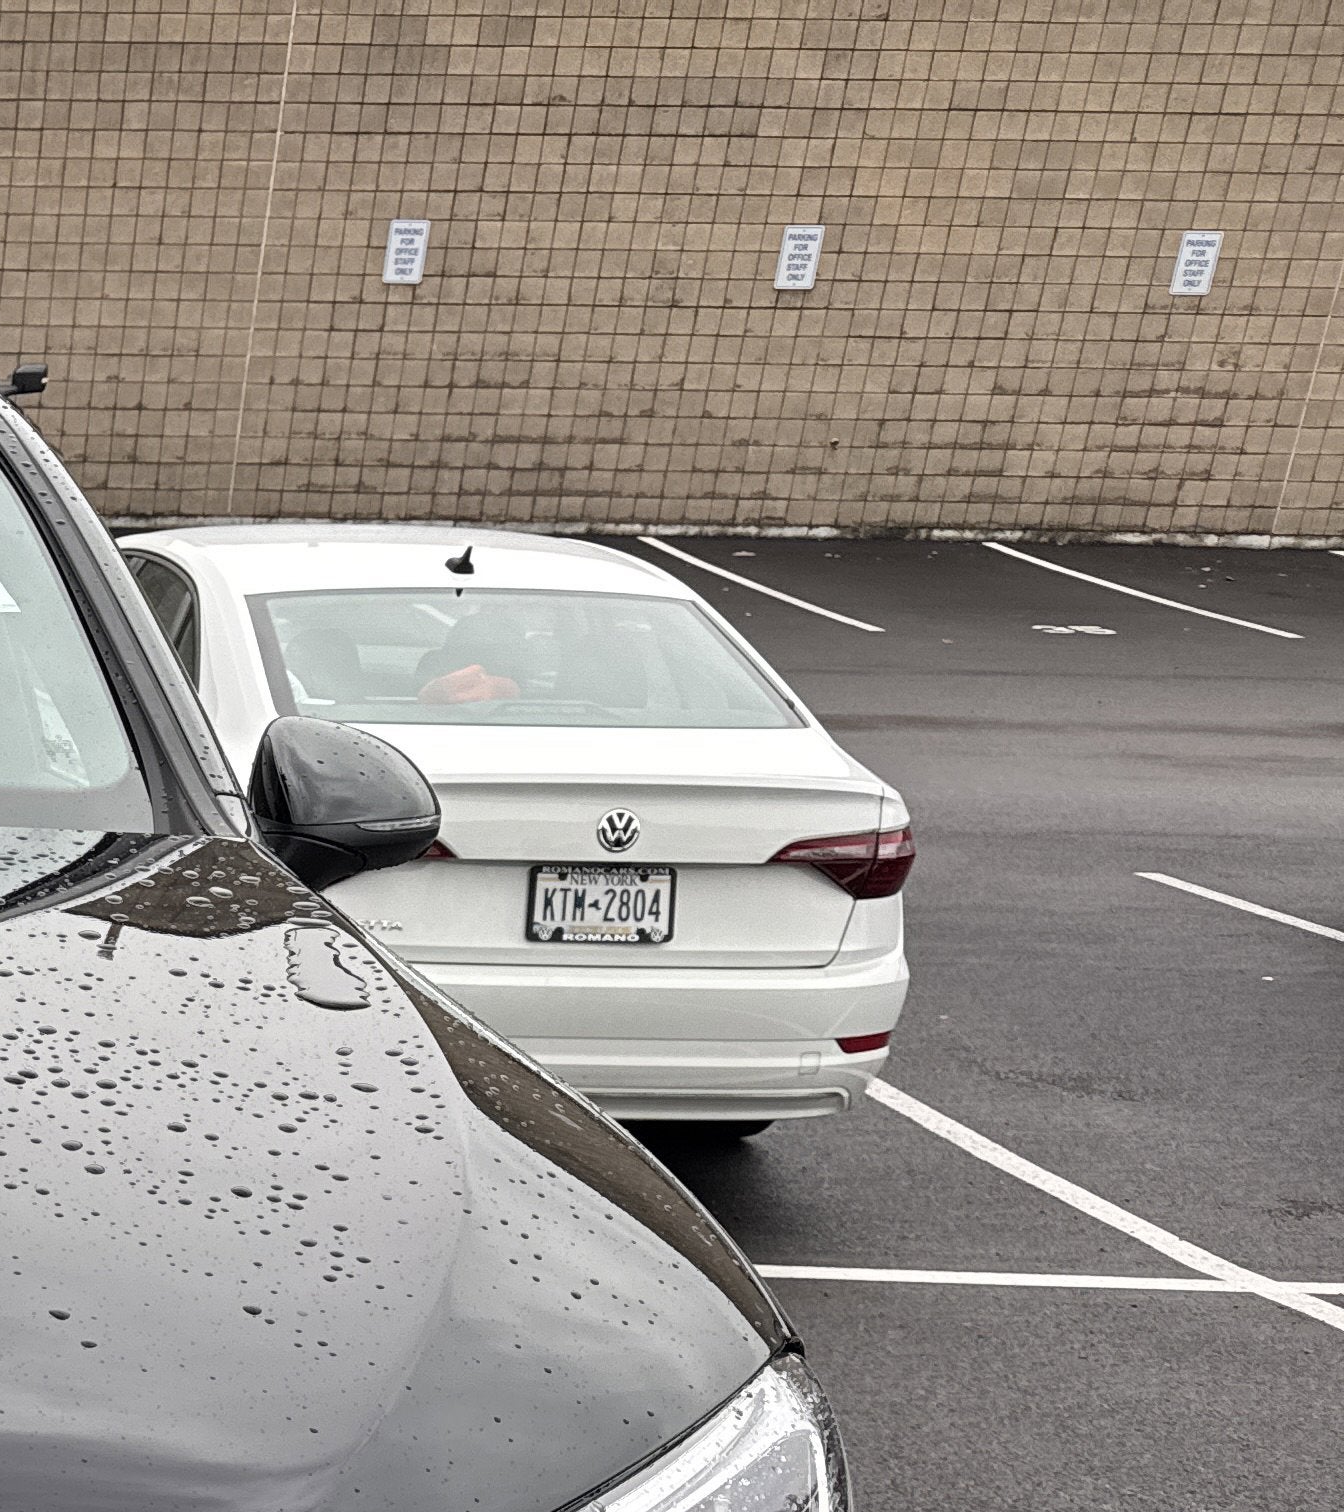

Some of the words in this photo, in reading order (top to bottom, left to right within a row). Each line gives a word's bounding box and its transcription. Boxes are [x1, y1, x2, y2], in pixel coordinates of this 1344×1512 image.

[787, 233, 818, 241] PARKING
[794, 243, 808, 251] FOR
[787, 253, 812, 261] OFFICE
[786, 263, 808, 271] STAFF
[786, 273, 805, 281] ONLY
[542, 866, 670, 875] ROMANOCARS.COM
[569, 873, 598, 886] NEW
[603, 873, 639, 886] YORK
[542, 887, 587, 921] KTM
[602, 888, 662, 923] 2804
[562, 933, 640, 942] ROMANO
